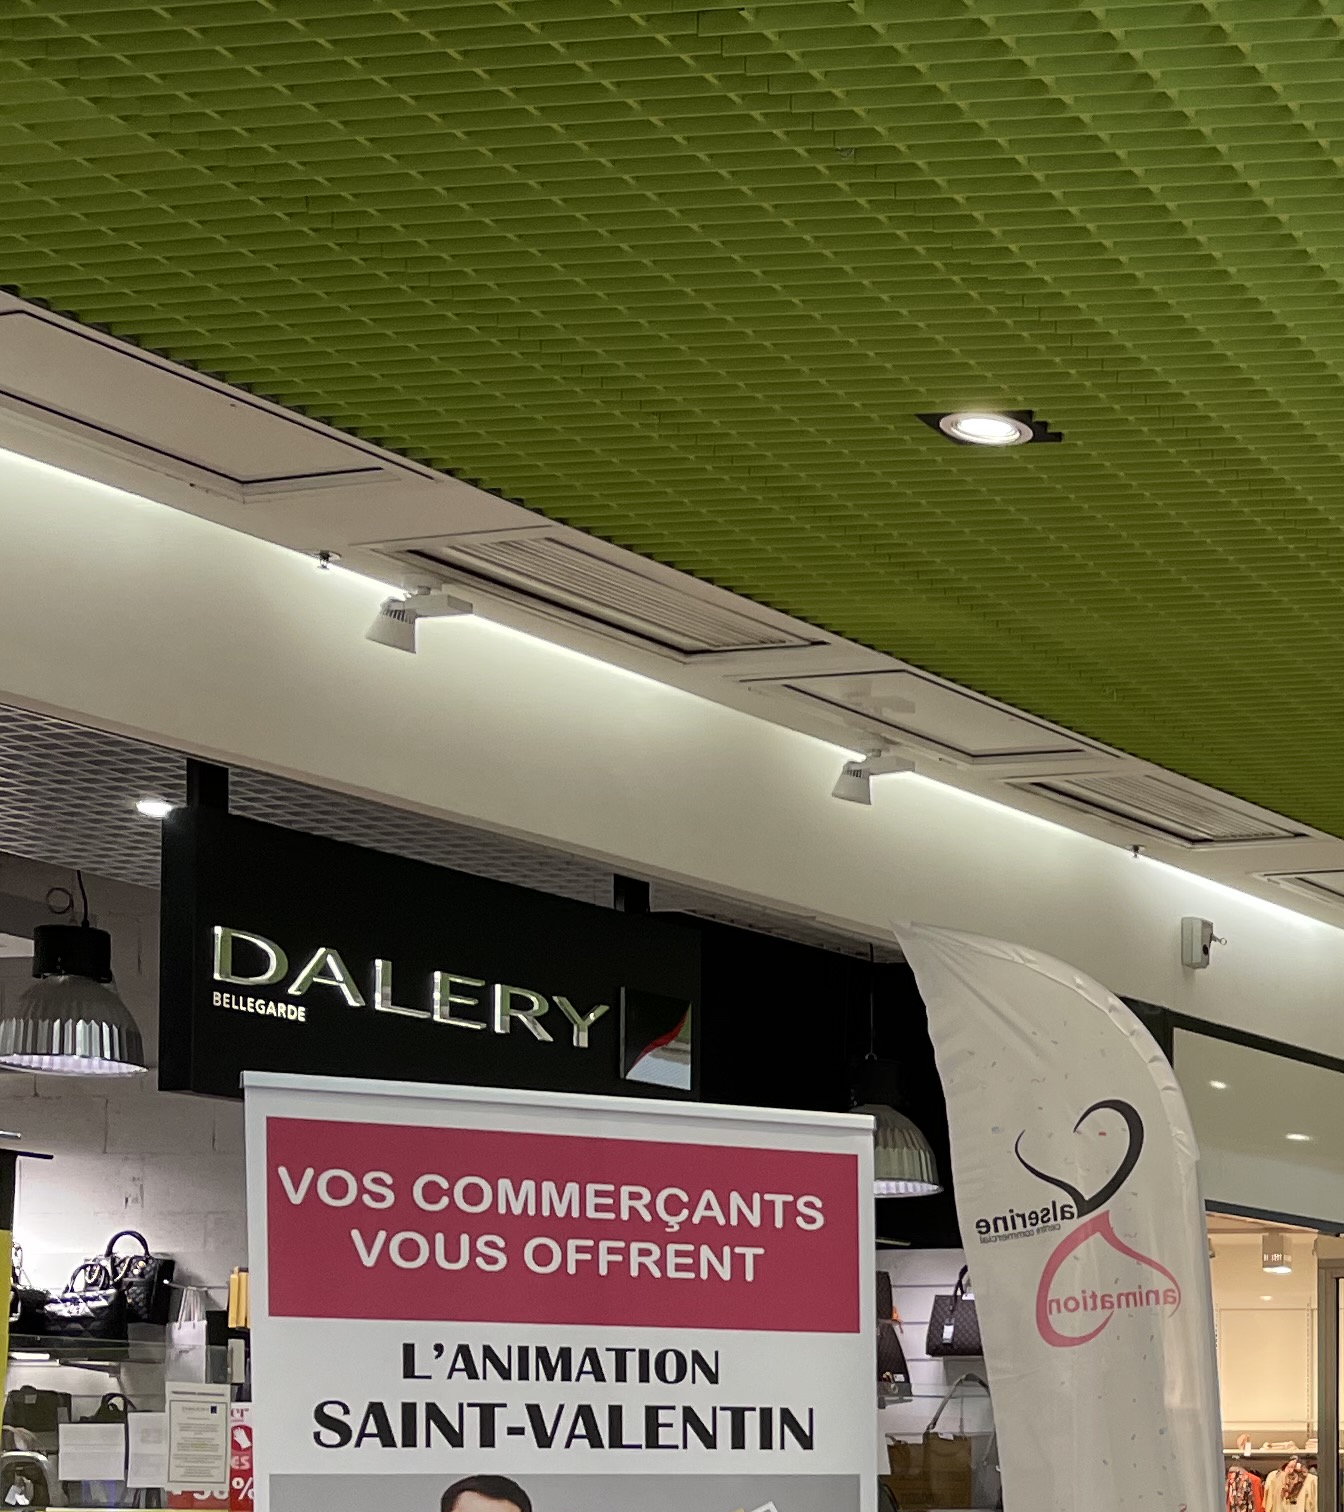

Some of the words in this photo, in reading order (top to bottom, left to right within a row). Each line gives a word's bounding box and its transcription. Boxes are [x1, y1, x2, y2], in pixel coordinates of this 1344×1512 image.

[212, 925, 610, 1049] DALERY
[212, 991, 306, 1023] BELLEGARDE
[277, 1165, 395, 1210] VOS
[412, 1173, 825, 1232] COMMERÇANTS
[350, 1229, 507, 1272] VOUS
[524, 1236, 765, 1283] OFFRENT
[402, 1341, 720, 1386] L'ANIMATION
[312, 1399, 815, 1451] SAINT-VALENTIN
